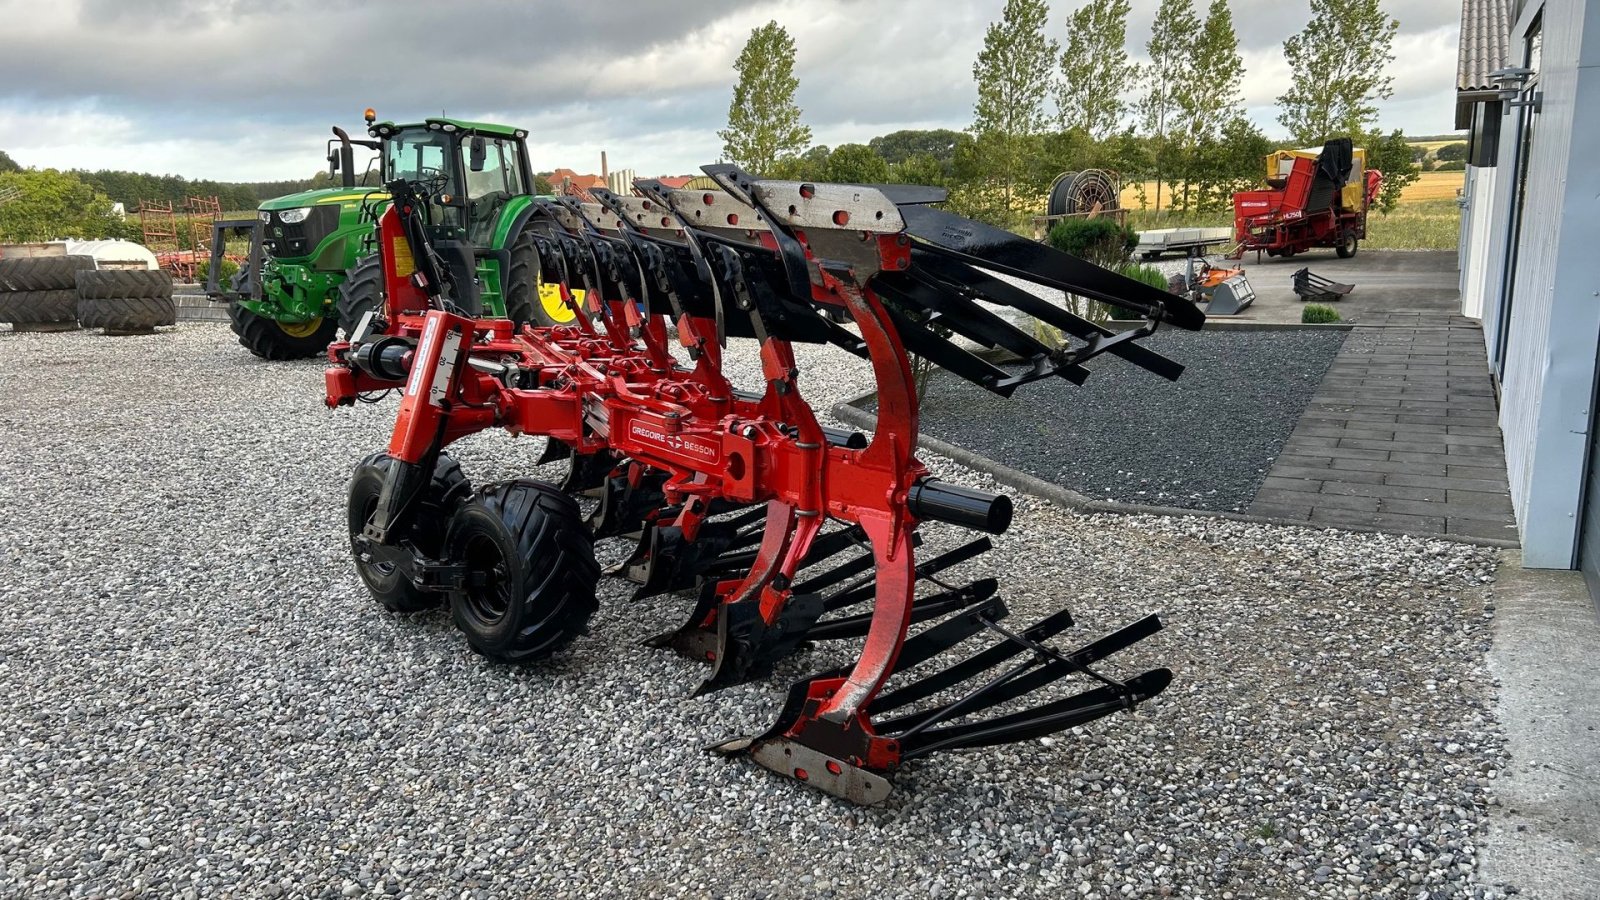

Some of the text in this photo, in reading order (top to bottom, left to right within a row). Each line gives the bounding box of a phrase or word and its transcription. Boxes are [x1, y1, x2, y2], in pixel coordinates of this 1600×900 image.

[447, 330, 454, 340] 30
[439, 356, 446, 366] 20
[432, 385, 438, 394] 10
[684, 441, 715, 456] BESSON
